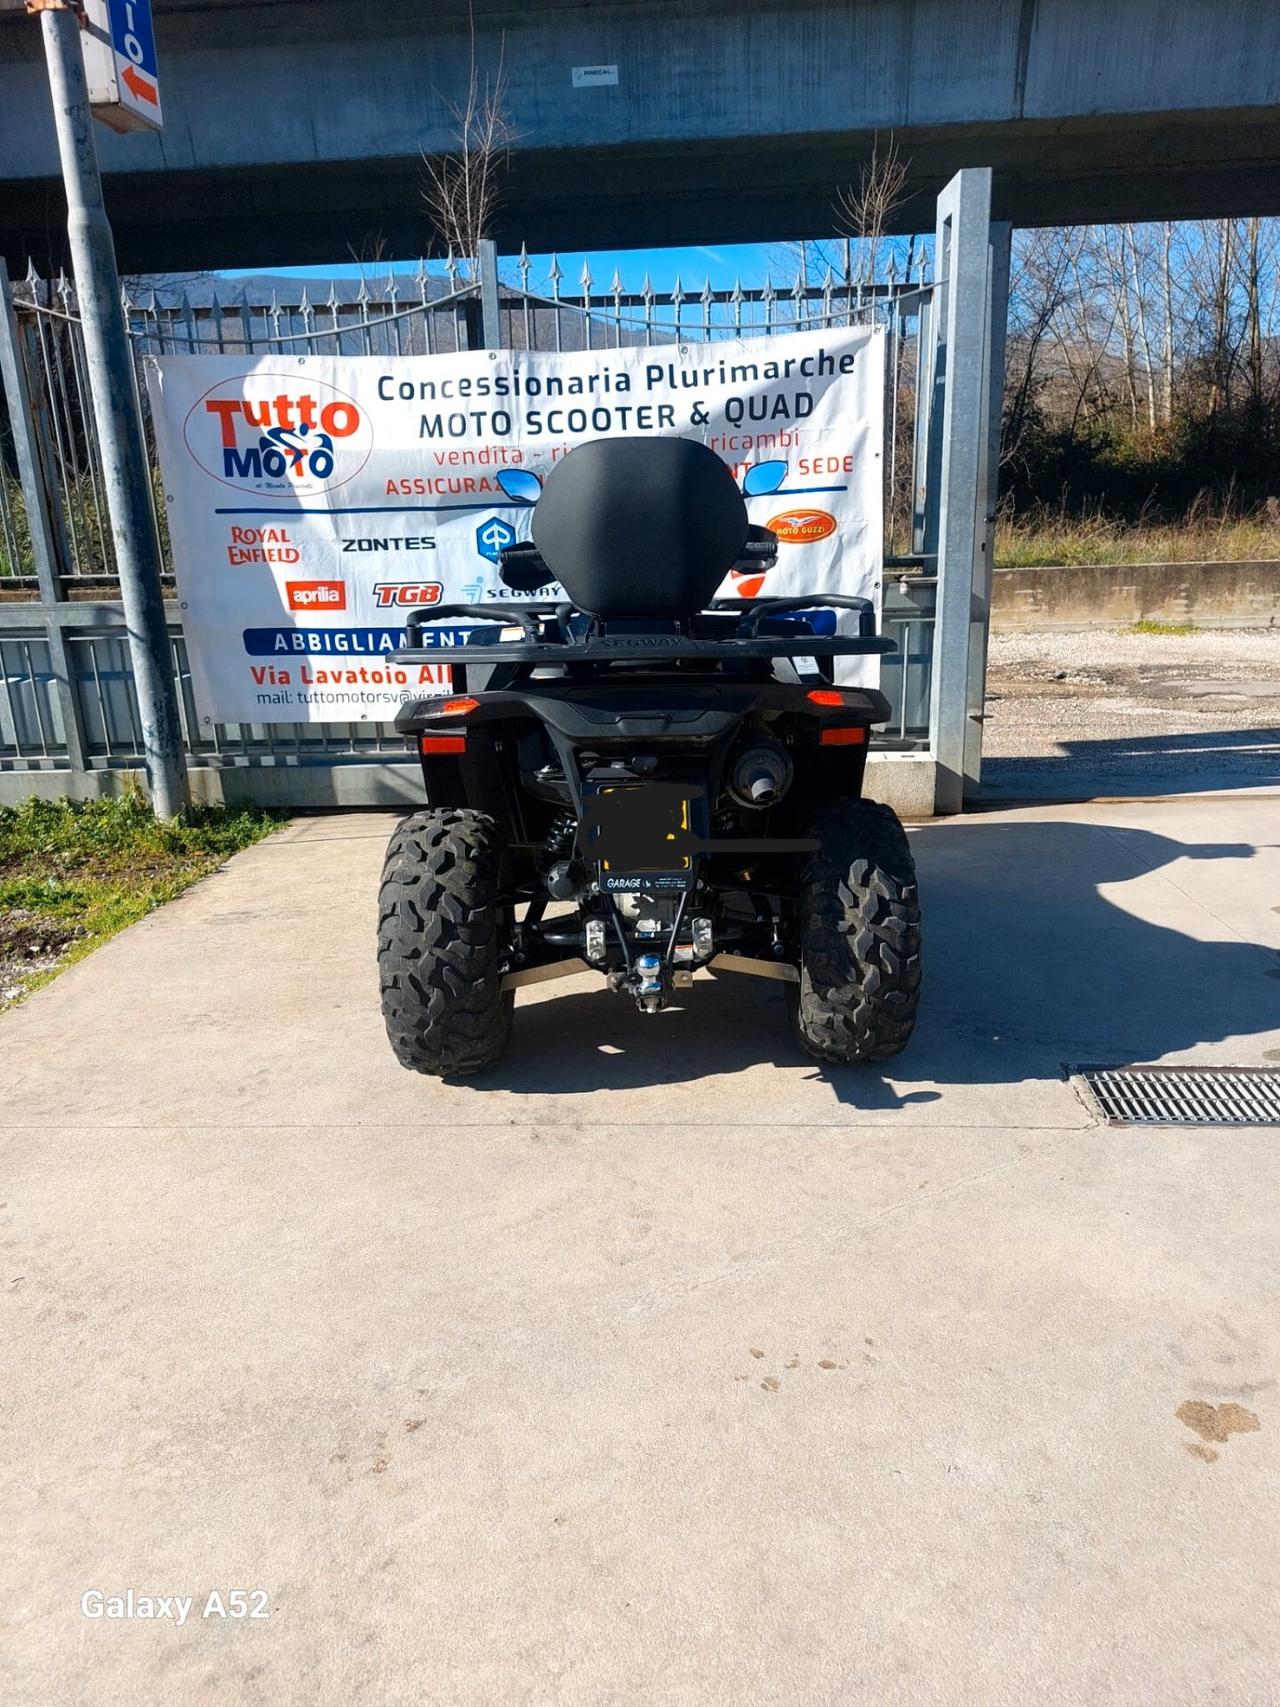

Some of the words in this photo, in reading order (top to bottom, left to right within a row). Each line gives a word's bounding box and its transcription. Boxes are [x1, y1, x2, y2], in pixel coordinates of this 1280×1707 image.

[378, 368, 631, 401] Concessionaria
[646, 348, 855, 391] Plurimarche
[419, 410, 511, 439] MOTO
[526, 405, 676, 435] SCOOTER
[690, 401, 710, 426] &
[724, 392, 814, 429] QUAD
[433, 445, 523, 466] vendita
[711, 428, 800, 452] ricambi
[798, 456, 854, 475] SEDE
[231, 527, 291, 545] ROYAL
[777, 527, 799, 535] MOTO
[801, 526, 825, 534] GUZZI
[342, 537, 436, 552] ZONTES
[227, 546, 300, 565] ENFIELD
[293, 586, 340, 605] aprilia
[374, 583, 441, 606] TGB
[487, 587, 562, 598] SEGWAY
[250, 665, 291, 685] Via
[300, 665, 408, 685] Lavatoio
[256, 690, 294, 705] mail:
[607, 878, 642, 889] GARAGE
